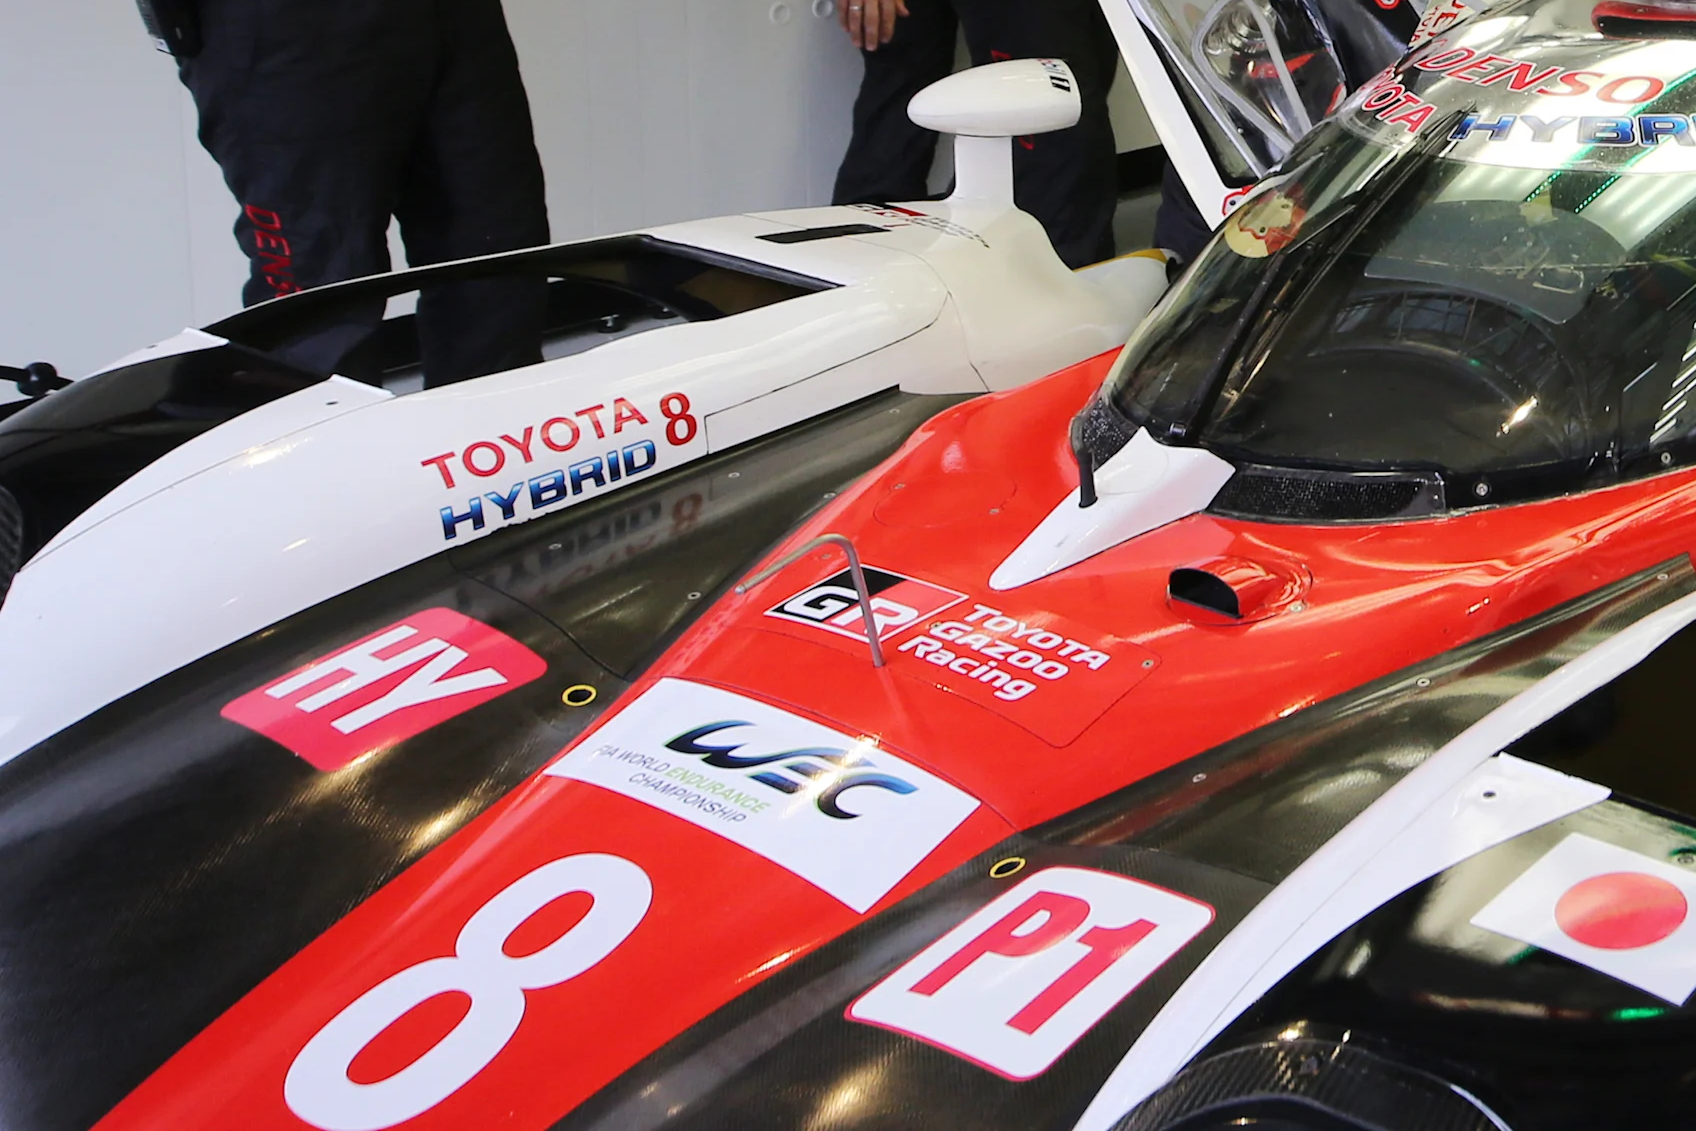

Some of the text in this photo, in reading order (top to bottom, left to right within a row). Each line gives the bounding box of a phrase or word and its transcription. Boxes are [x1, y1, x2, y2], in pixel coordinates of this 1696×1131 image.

[1414, 46, 1667, 106] DENSO
[245, 204, 302, 298] DENS
[421, 392, 697, 490] TOYOTA 8
[440, 439, 657, 540] HYBRID
[783, 584, 920, 638] GR
[929, 620, 1069, 680] GAZOO
[963, 603, 1111, 671] TOYOTA
[264, 624, 508, 735] HY
[897, 635, 1037, 701] Racing
[612, 747, 671, 774] WORLD
[664, 766, 771, 814] ENDURANCE
[628, 772, 748, 824] CHAMPIONSHIP
[663, 719, 919, 821] WEC
[283, 853, 653, 1131] 8
[907, 890, 1159, 1036] P1
